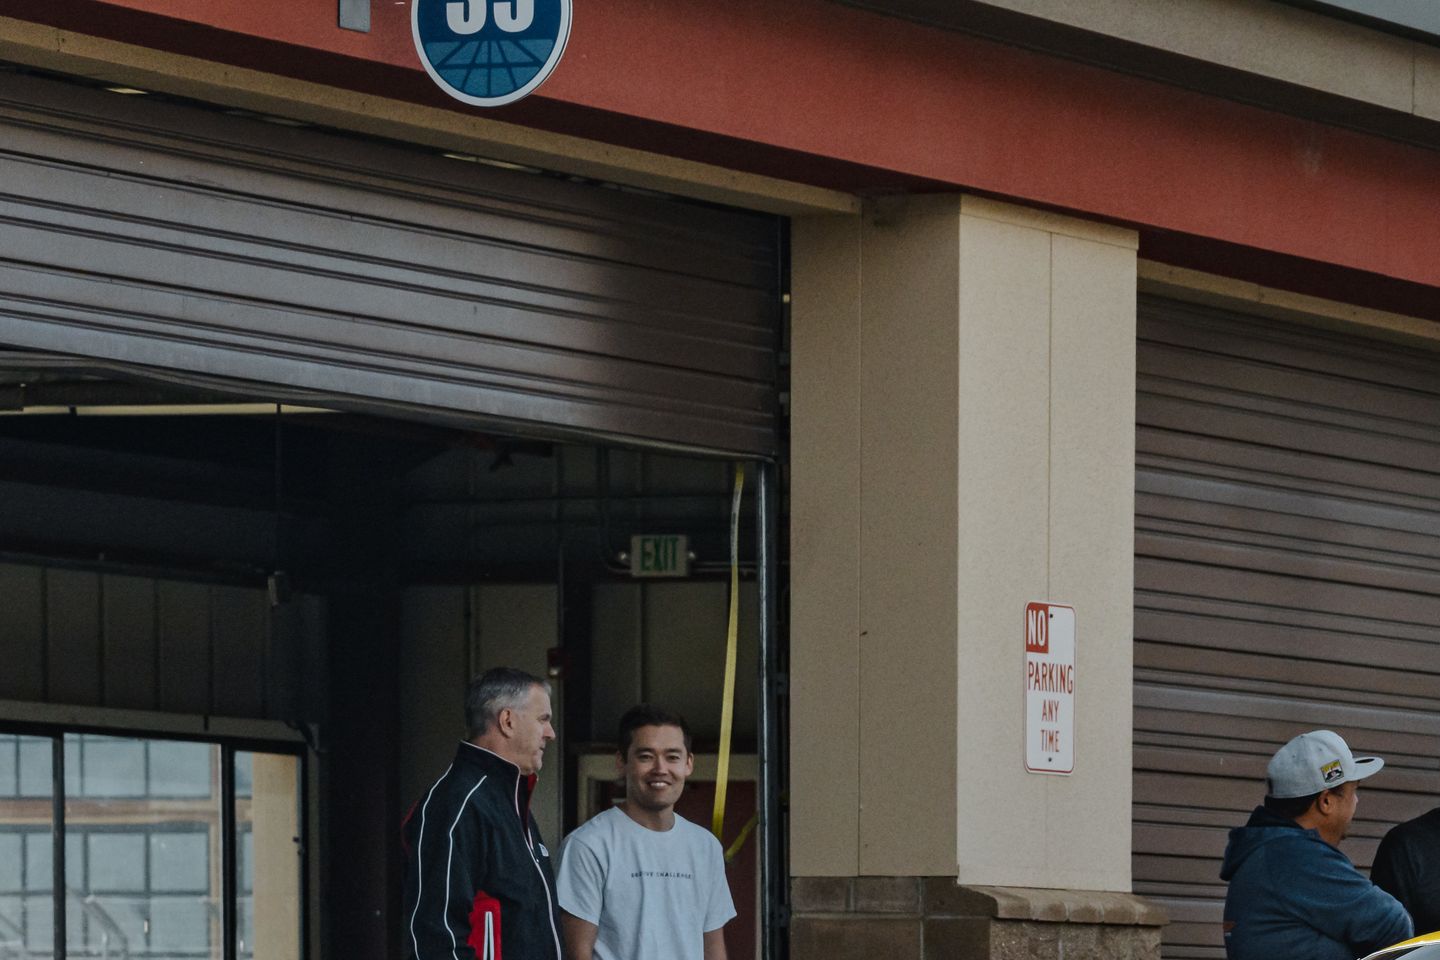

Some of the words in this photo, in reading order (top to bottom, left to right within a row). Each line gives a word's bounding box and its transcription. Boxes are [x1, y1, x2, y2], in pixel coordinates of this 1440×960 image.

[640, 537, 679, 571] EXIT
[1028, 609, 1046, 646] NO
[1028, 661, 1073, 694] PARKING
[1041, 700, 1060, 722] ANY
[1040, 730, 1060, 752] TIME
